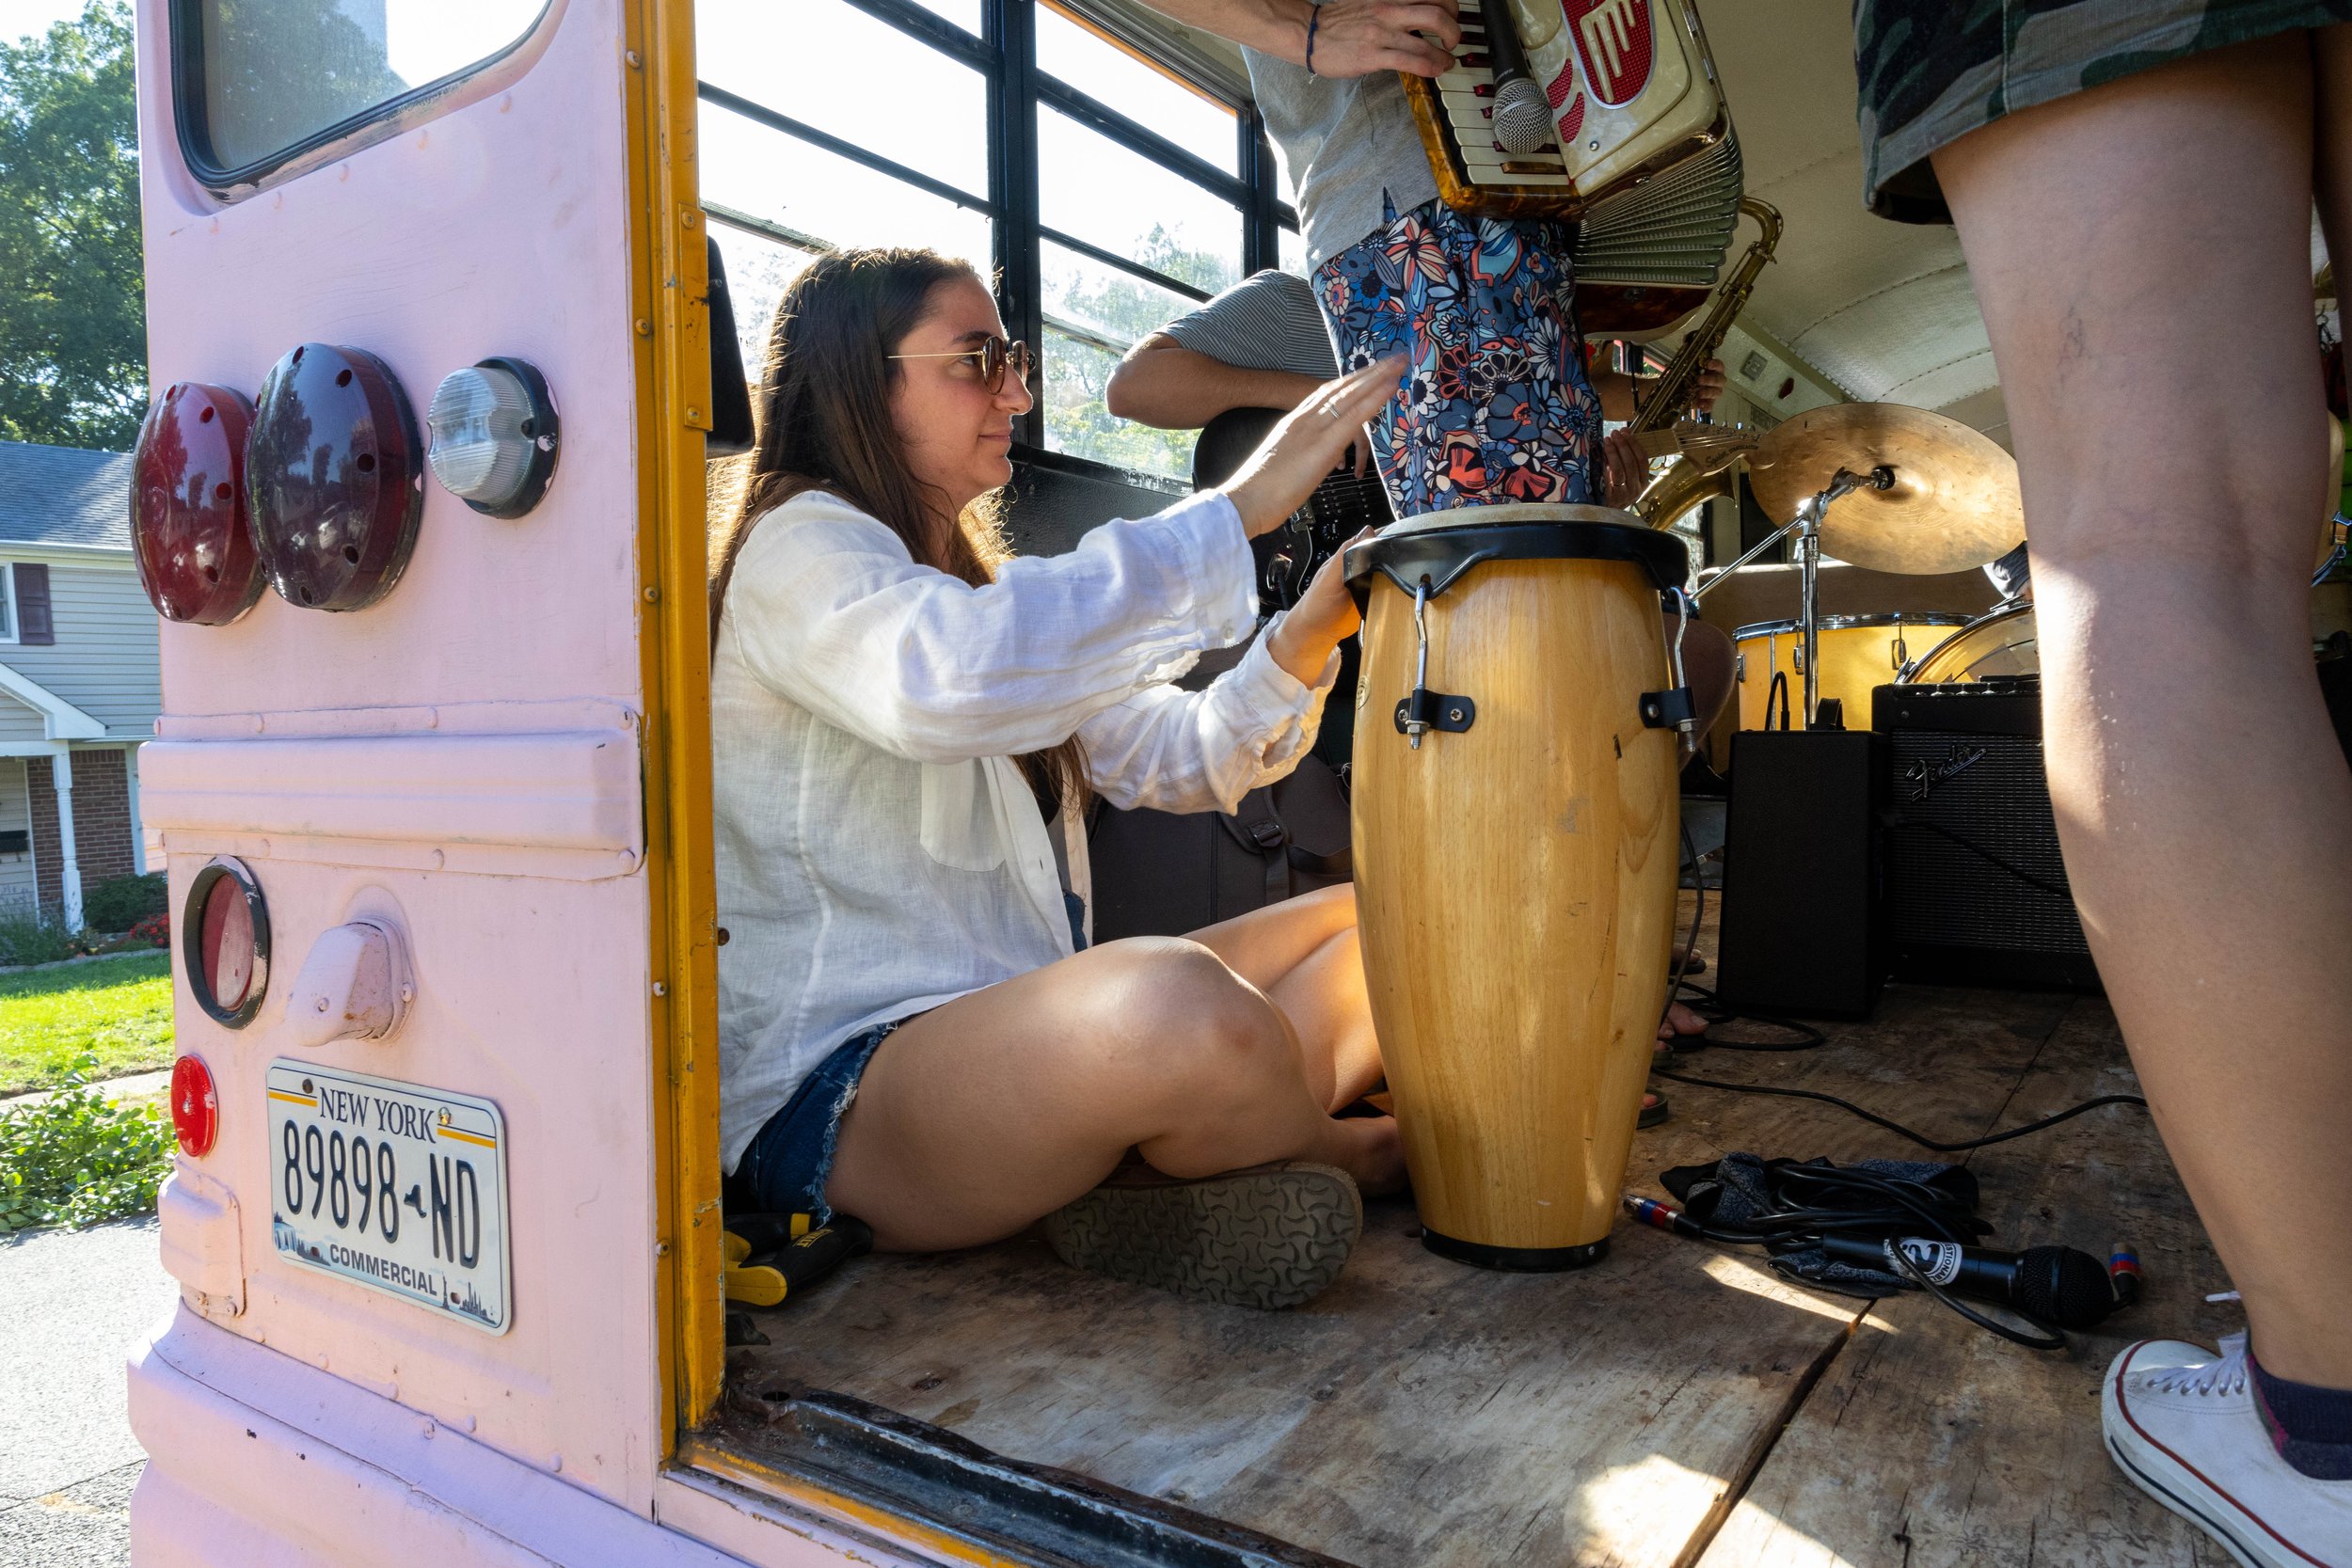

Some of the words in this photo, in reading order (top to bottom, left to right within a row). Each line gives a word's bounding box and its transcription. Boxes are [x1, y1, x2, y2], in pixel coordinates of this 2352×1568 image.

[1906, 745, 1986, 801] Fender
[319, 1086, 370, 1128] NEW
[373, 1098, 437, 1144] YORK
[283, 1119, 400, 1243] 89898
[430, 1153, 481, 1270] ND
[330, 1243, 437, 1296] COMMERCIAL
